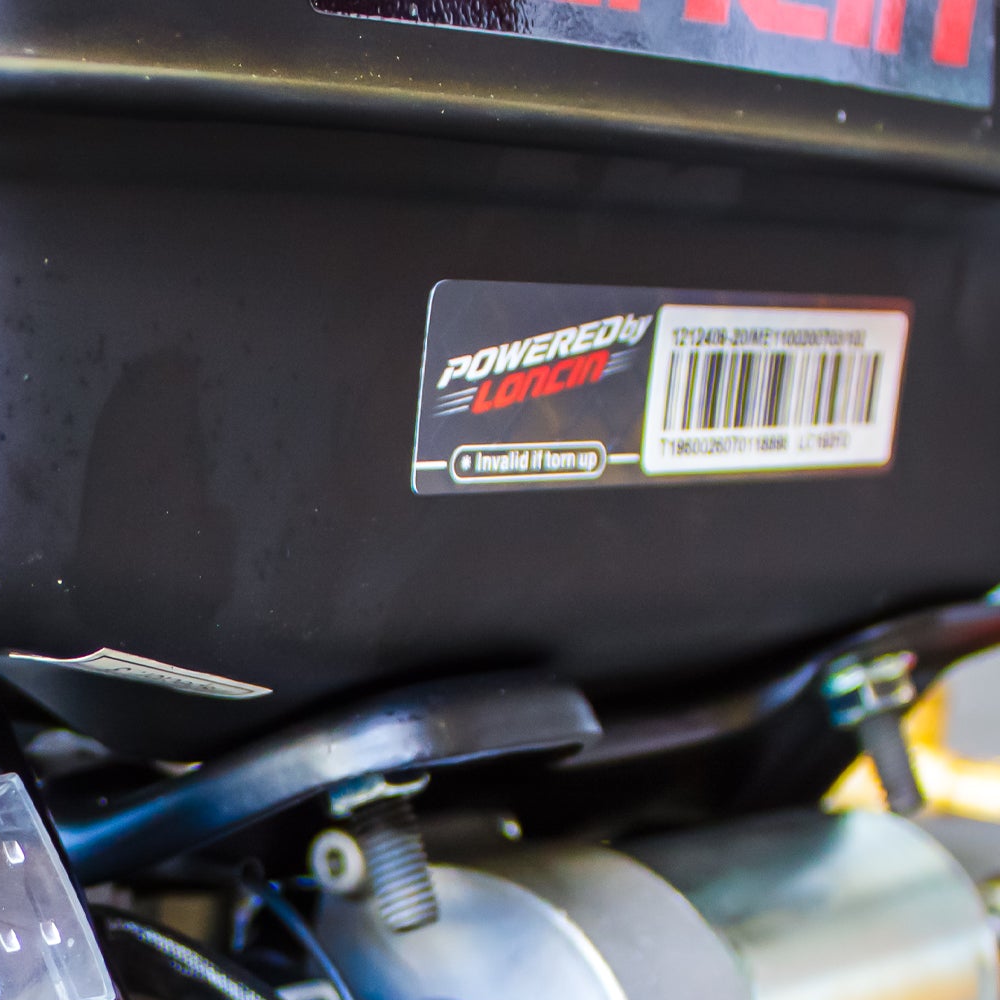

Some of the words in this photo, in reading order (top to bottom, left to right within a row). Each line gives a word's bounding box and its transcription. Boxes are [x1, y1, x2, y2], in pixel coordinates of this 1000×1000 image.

[436, 316, 624, 390] POWERED
[475, 450, 530, 472] Invalid
[577, 451, 599, 471] up
